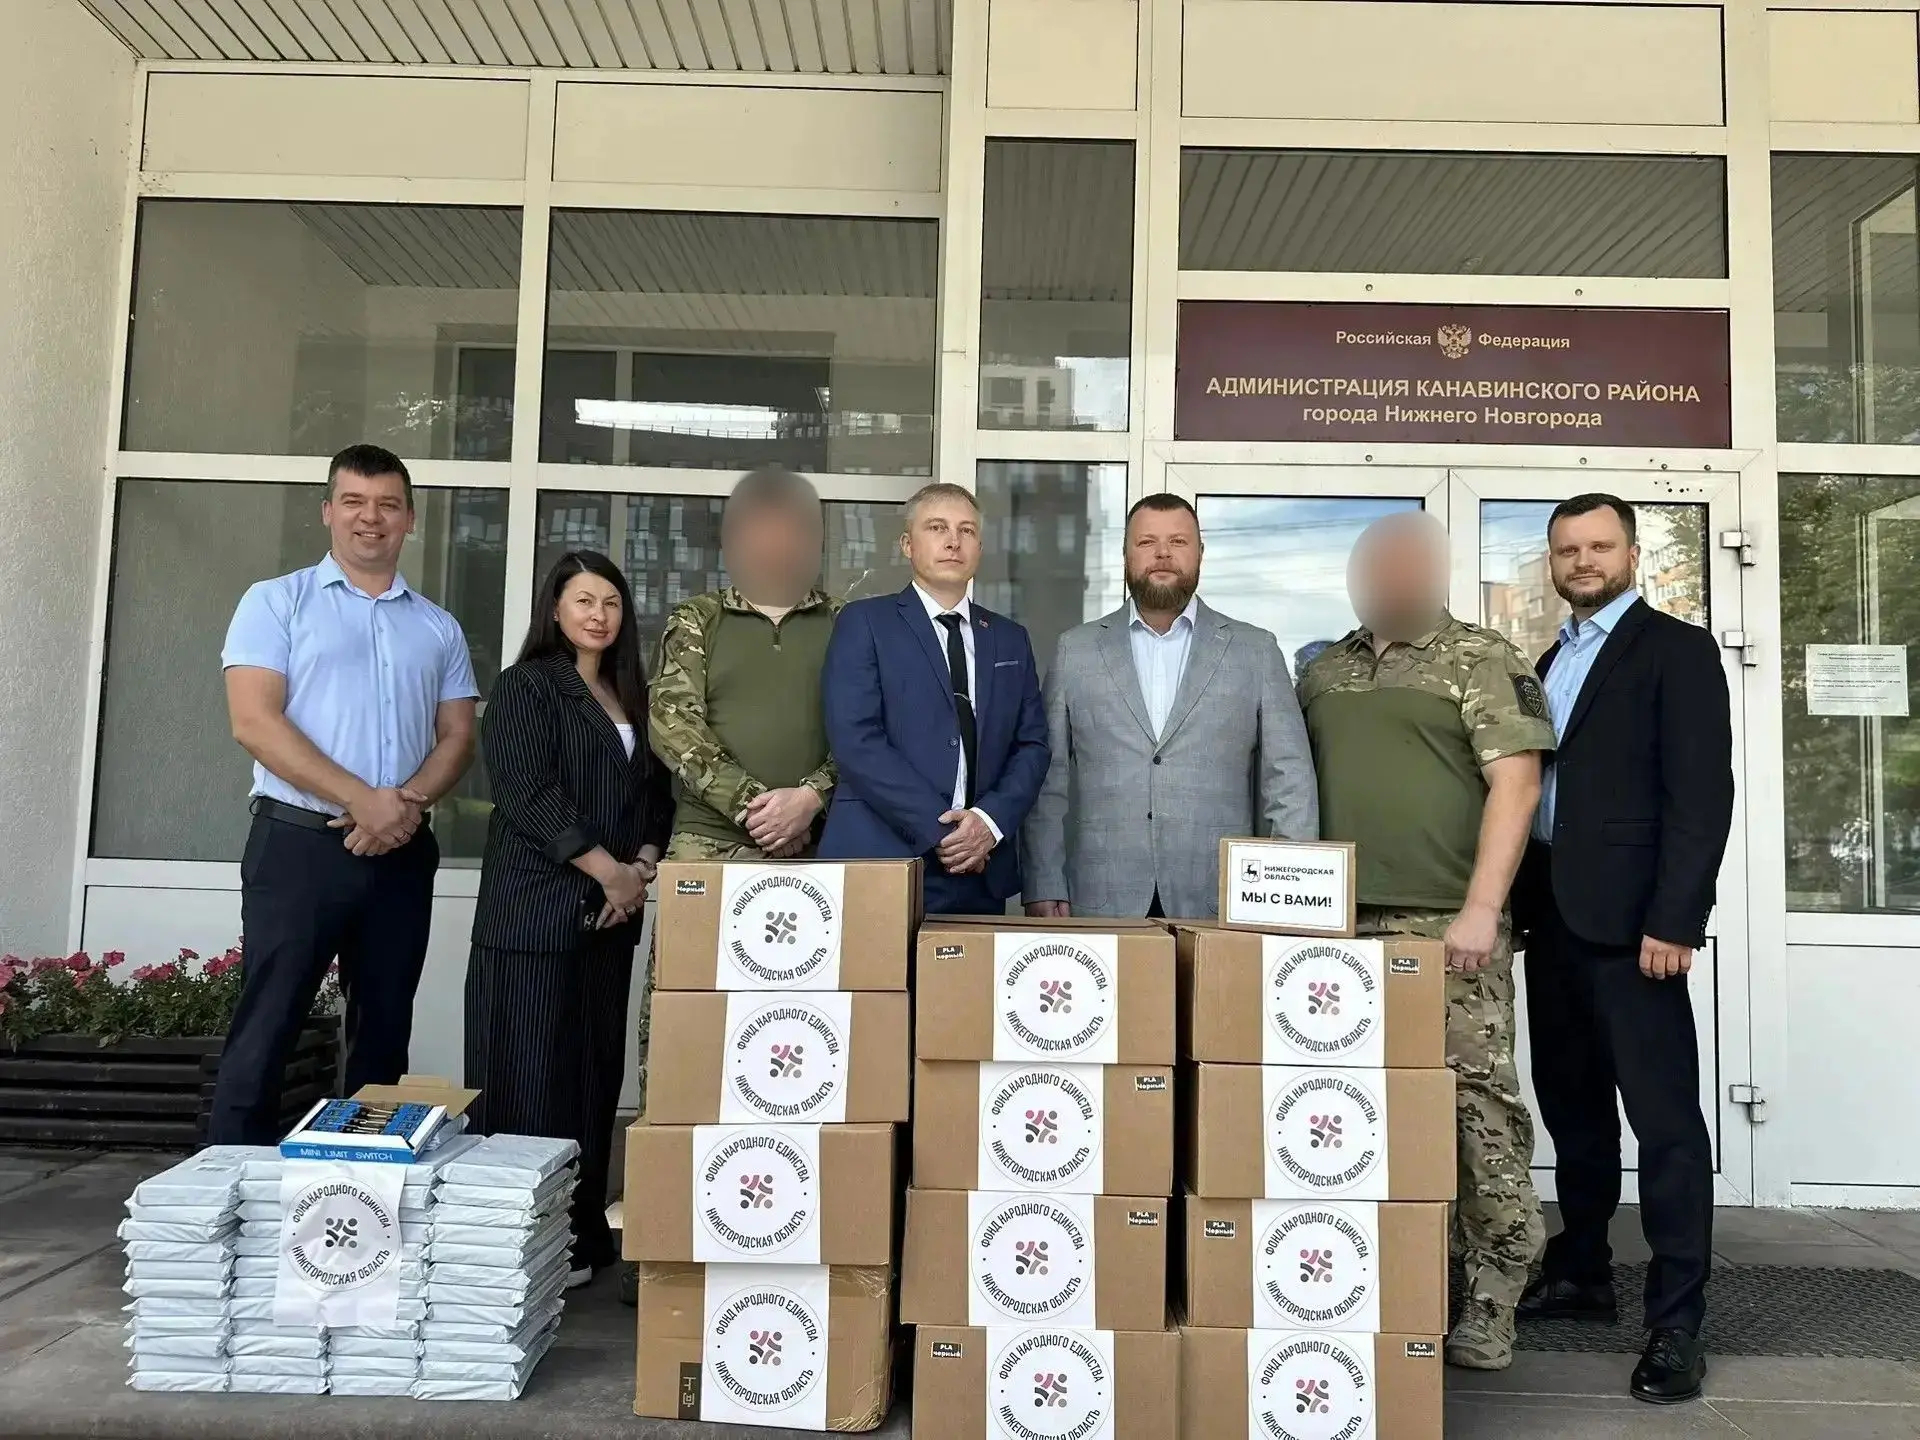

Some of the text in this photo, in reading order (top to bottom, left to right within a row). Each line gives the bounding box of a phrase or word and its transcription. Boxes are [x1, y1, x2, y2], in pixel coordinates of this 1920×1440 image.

[1336, 330, 1570, 351] Российская Федерация
[1206, 377, 1701, 403] АДМИНИСТРАЦИЯ КАНАВИНСКОГО РАЙОНА
[1303, 405, 1603, 430] города Нижнего Новгорода
[1264, 865, 1335, 876] НИЖЕГОРОДСКАЯ
[1264, 873, 1301, 882] ОБЛАСТЬ
[733, 877, 832, 922] ФОНД НАРОДНОГО ЕДИНСТВА
[1241, 891, 1333, 908] МЫ С ВАМИ!
[732, 940, 827, 981] НИЖЕГОРОДСКАЯ ОБЛАСТЬ
[1006, 945, 1107, 990] ФОНД НАРОДНОГО ЕДИНСТВА
[1275, 947, 1374, 992] ФОНД НАРОДНОГО ЕДИНСТВА
[737, 1008, 839, 1055] ФОНД НАРОДНОГО ЕДИНСТВА
[1007, 1011, 1103, 1051] НИЖЕГОРОДСКАЯ ОБЛАСТЬ
[1276, 1012, 1371, 1052] НИЖЕГОРОДСКАЯ ОБЛАСТЬ
[736, 1075, 833, 1116] НИЖЕГОРОДСКАЯ ОБЛАСТЬ
[992, 1073, 1093, 1120] ФОНД НАРОДНОГО ЕДИНСТВА
[1276, 1078, 1377, 1124] ФОНД НАРОДНОГО ЕДИНСТВА
[300, 1148, 394, 1161] MINI LIMIT SWITCH
[706, 1137, 809, 1183] ФОНД НАРОДНОГО ЕДИНСТВА
[992, 1140, 1089, 1182] НИЖЕГОРОДСКАЯ ОБЛАСТЬ
[1277, 1146, 1374, 1187] НИЖЕГОРОДСКАЯ ОБЛАСТЬ
[293, 1184, 391, 1228] ФОНД НАРОДНОГО ЕДИНСТВА
[981, 1203, 1084, 1250] ФОНД НАРОДНОГО ЕДИНСТВА
[706, 1208, 805, 1249] НИЖЕГОРОДСКАЯ ОБЛАСТЬ
[1265, 1212, 1368, 1258] ФОНД НАРОДНОГО ЕДИНСТВА
[292, 1246, 390, 1285] НИЖЕГОРОДСКАЯ ОБЛАСТЬ
[982, 1273, 1081, 1314] НИЖЕГОРОДСКАЯ ОБЛАСТЬ
[1266, 1281, 1365, 1321] НИЖЕГОРОДСКАЯ ОБЛАСТЬ
[716, 1293, 818, 1342] ФОНД НАРОДНОГО ЕДИНСТВА
[999, 1335, 1104, 1382] ФОНД НАРОДНОГО ЕДИНСТВА
[1261, 1341, 1365, 1389] ФОНД НАРОДНОГО ЕДИНСТВА
[715, 1361, 780, 1405] НИЖЕГОРОДСКАЯ
[781, 1370, 813, 1400] ОБЛАСТЬ
